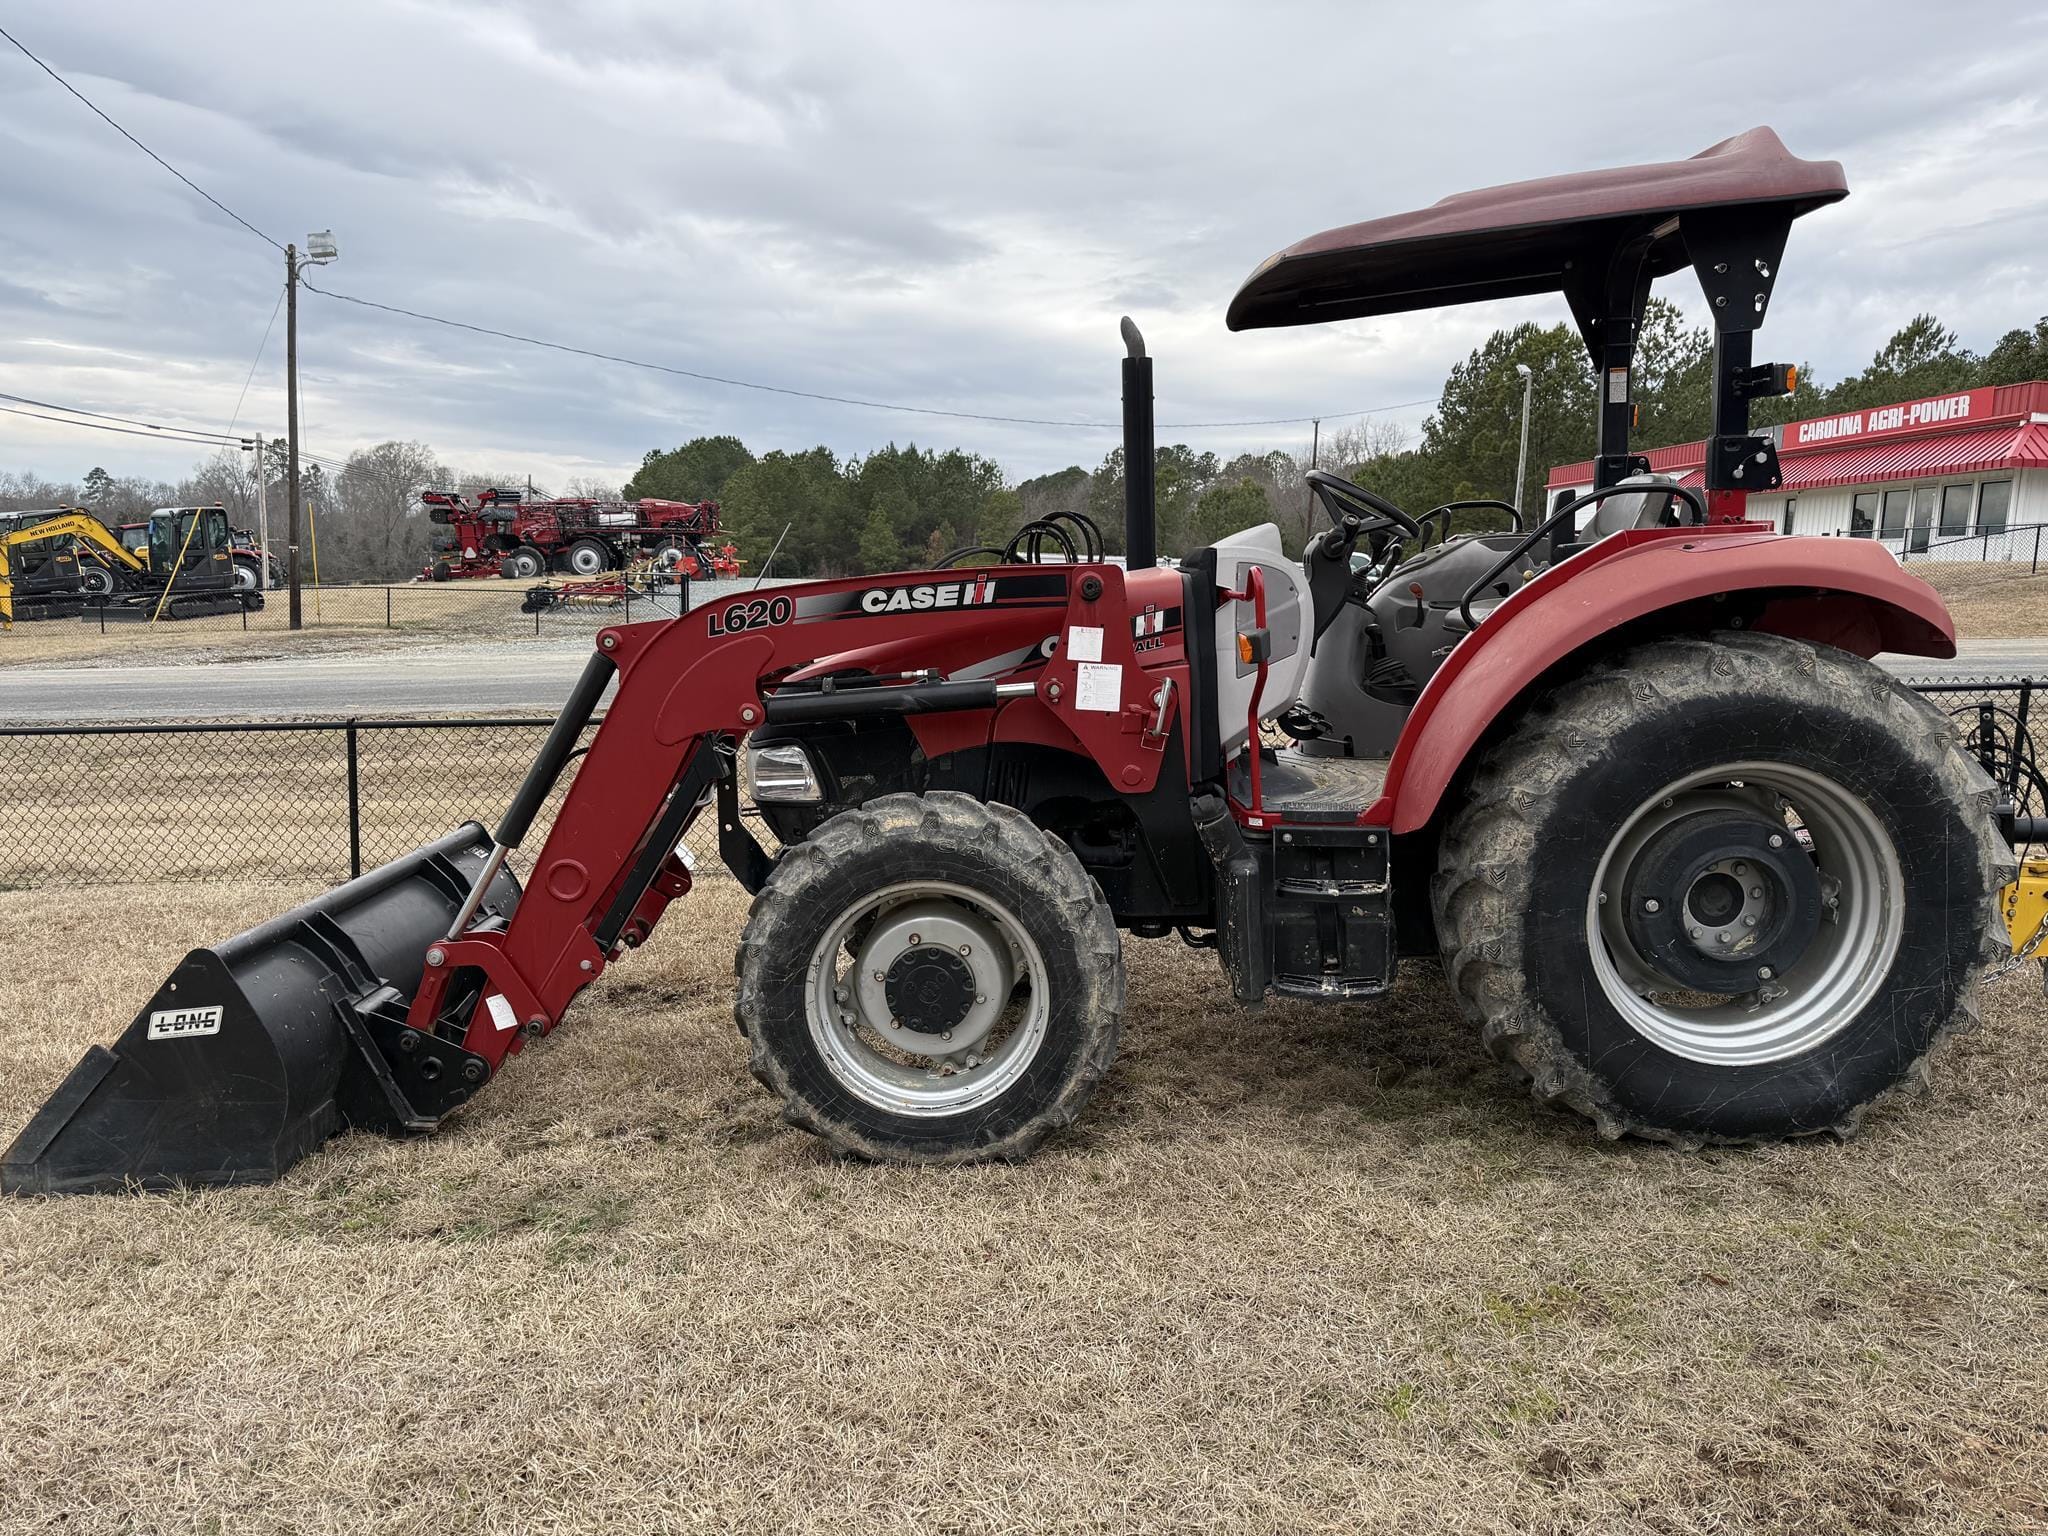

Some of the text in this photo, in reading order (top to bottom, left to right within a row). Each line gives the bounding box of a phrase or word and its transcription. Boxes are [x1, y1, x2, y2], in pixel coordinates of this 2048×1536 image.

[1798, 395, 1971, 443] CAROLINA AGRI-POWER
[46, 520, 75, 532] HOLLAND
[862, 584, 959, 612] CASE
[707, 596, 792, 638] L620
[155, 1011, 217, 1032] LONG
